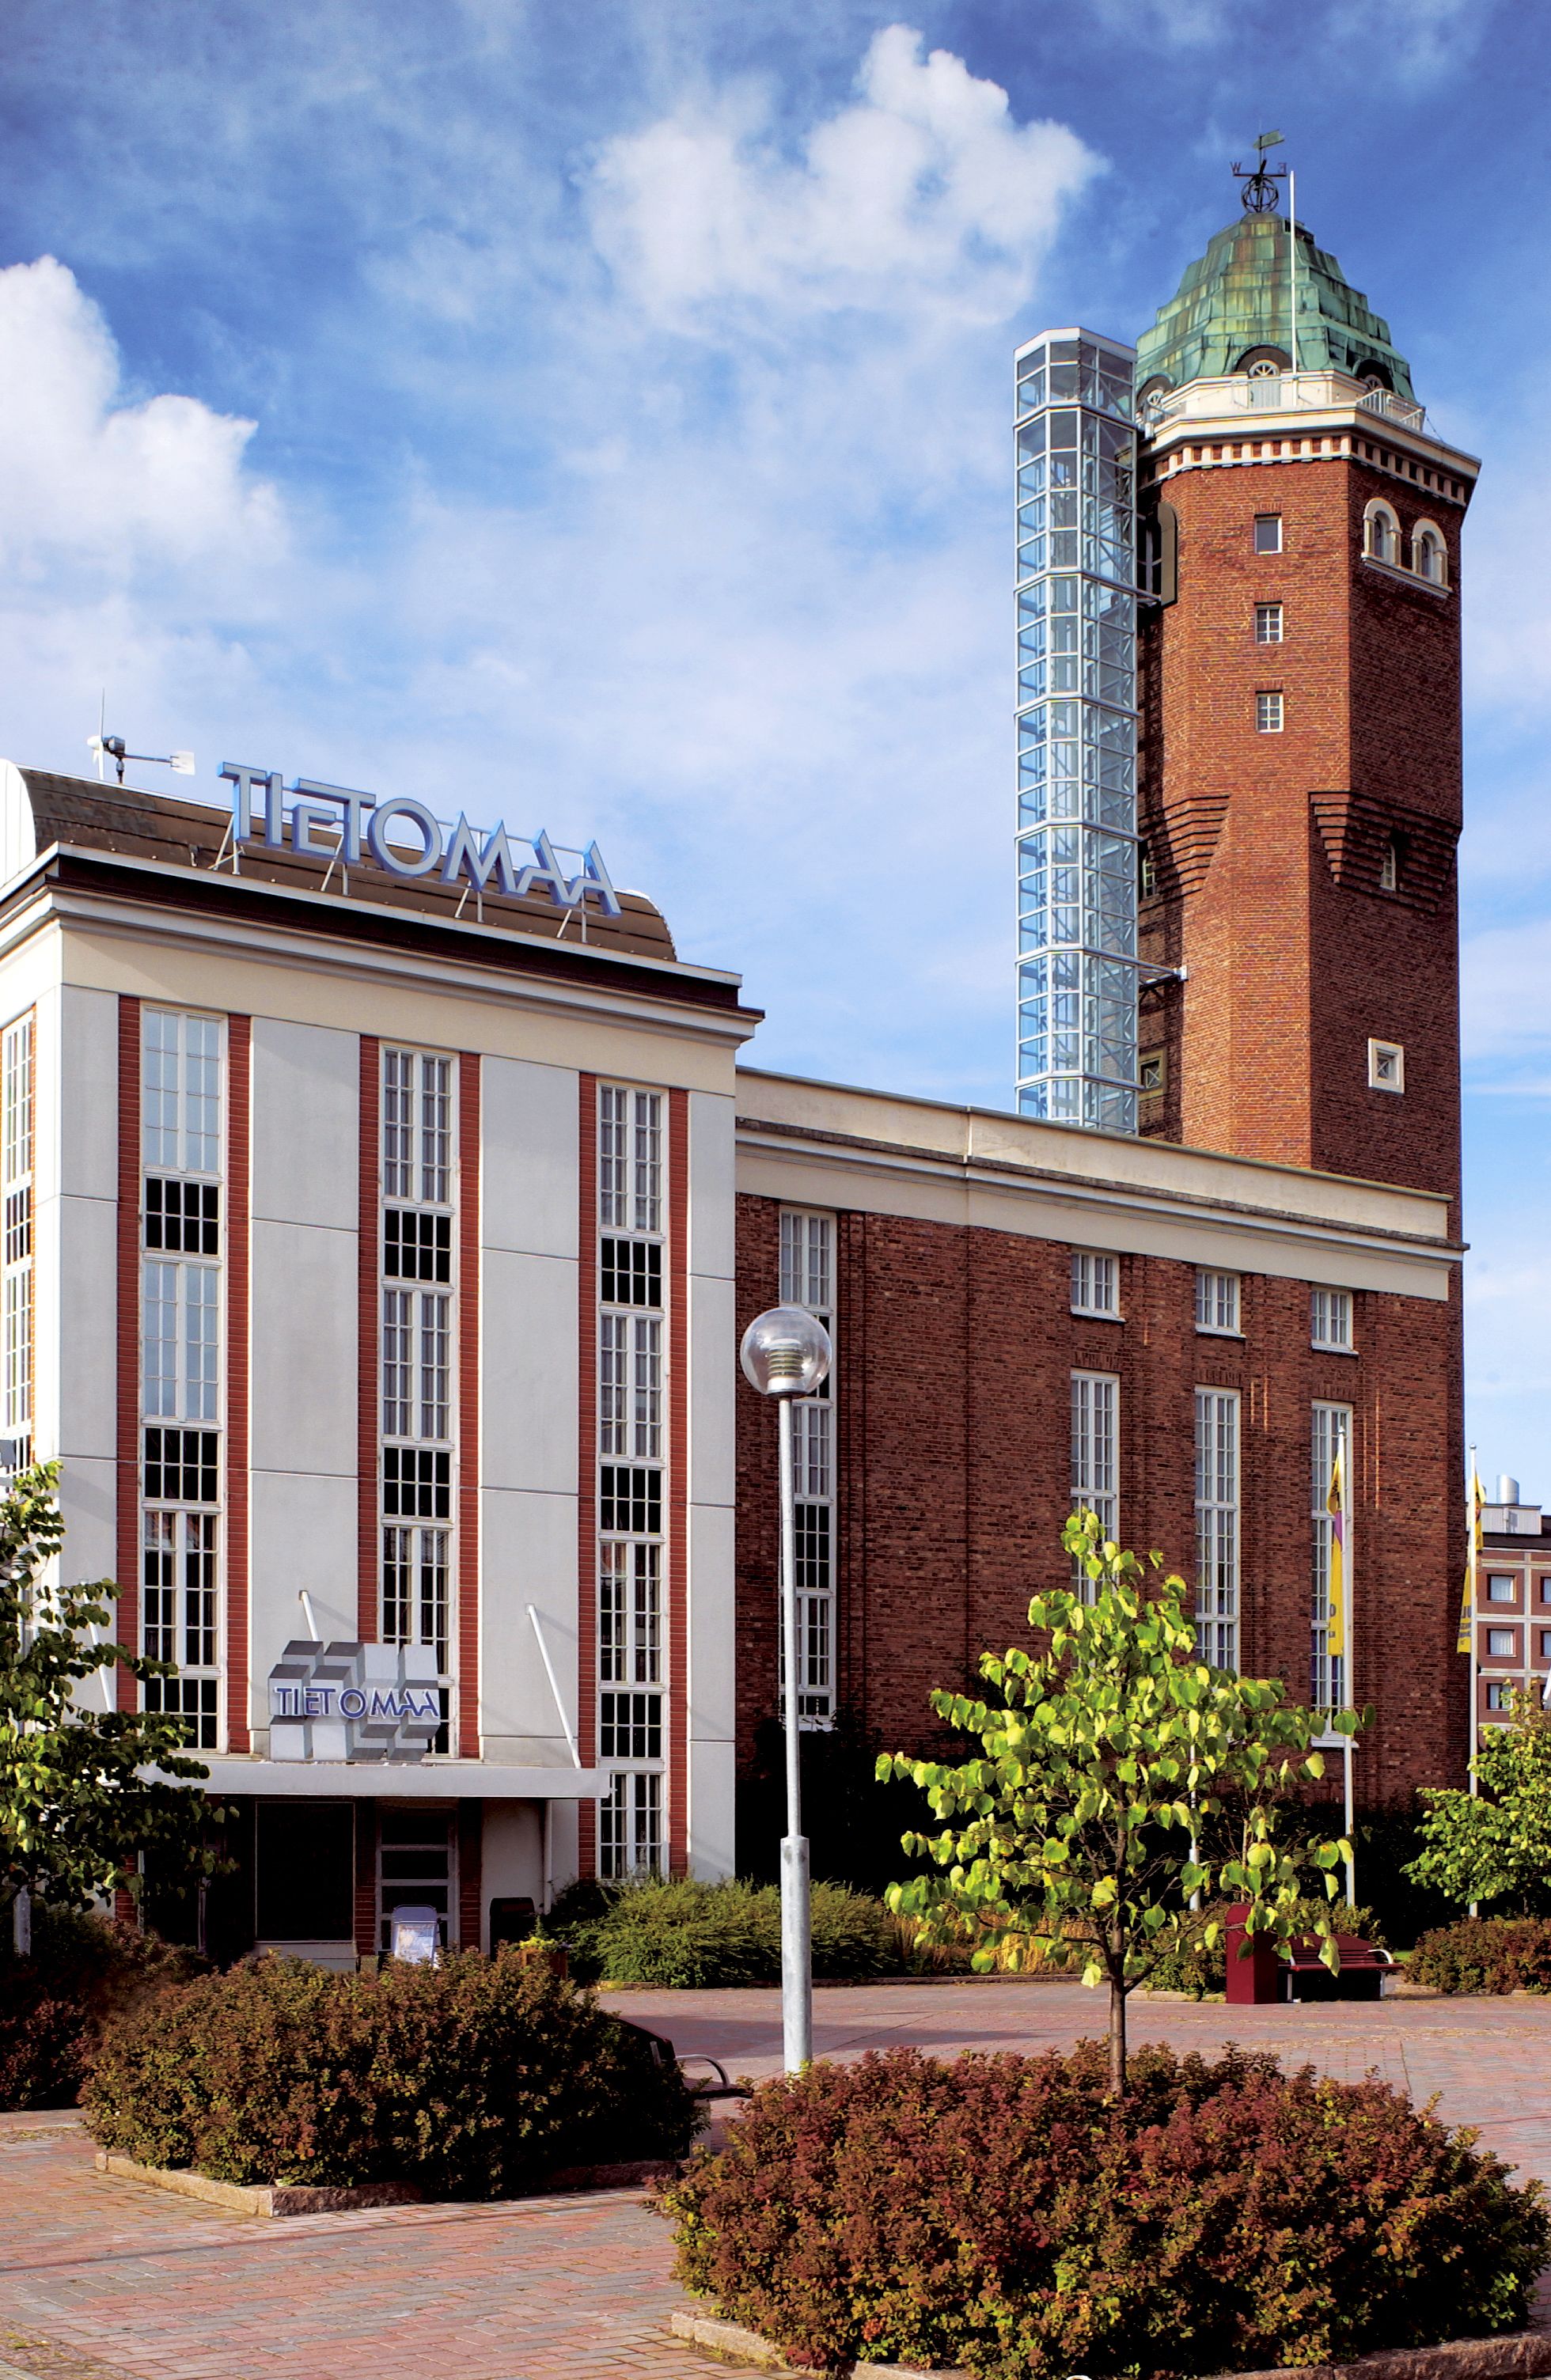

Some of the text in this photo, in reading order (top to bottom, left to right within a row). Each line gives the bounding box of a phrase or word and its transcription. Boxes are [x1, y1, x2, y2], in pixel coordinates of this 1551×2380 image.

[1229, 161, 1242, 174] W
[218, 761, 623, 919] TIETOMAA
[275, 1687, 439, 1719] TIETOMAA
